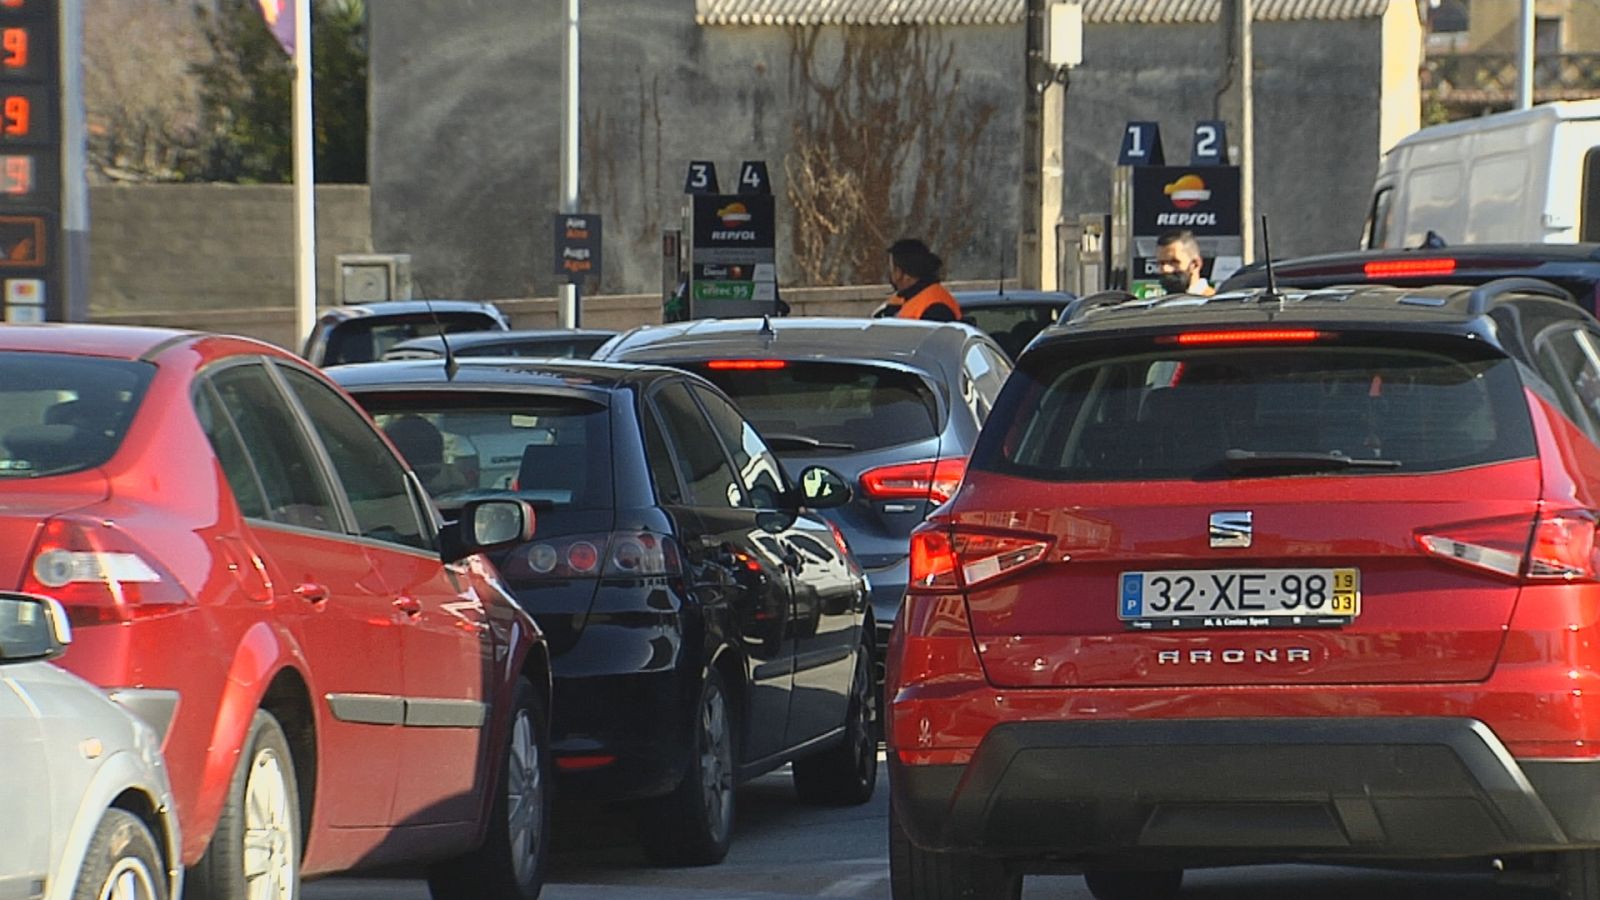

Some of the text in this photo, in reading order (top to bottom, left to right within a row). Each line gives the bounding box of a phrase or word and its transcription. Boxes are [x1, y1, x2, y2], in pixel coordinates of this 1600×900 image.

[1127, 126, 1145, 157] 1
[1196, 126, 1218, 156] 2
[691, 165, 708, 187] 3
[743, 166, 761, 187] 4
[1156, 213, 1217, 225] REPSOL
[711, 230, 756, 240] REPSOL
[1334, 574, 1353, 588] 19
[1127, 600, 1137, 610] P
[1332, 596, 1351, 609] 03
[1157, 649, 1311, 664] ARONA
